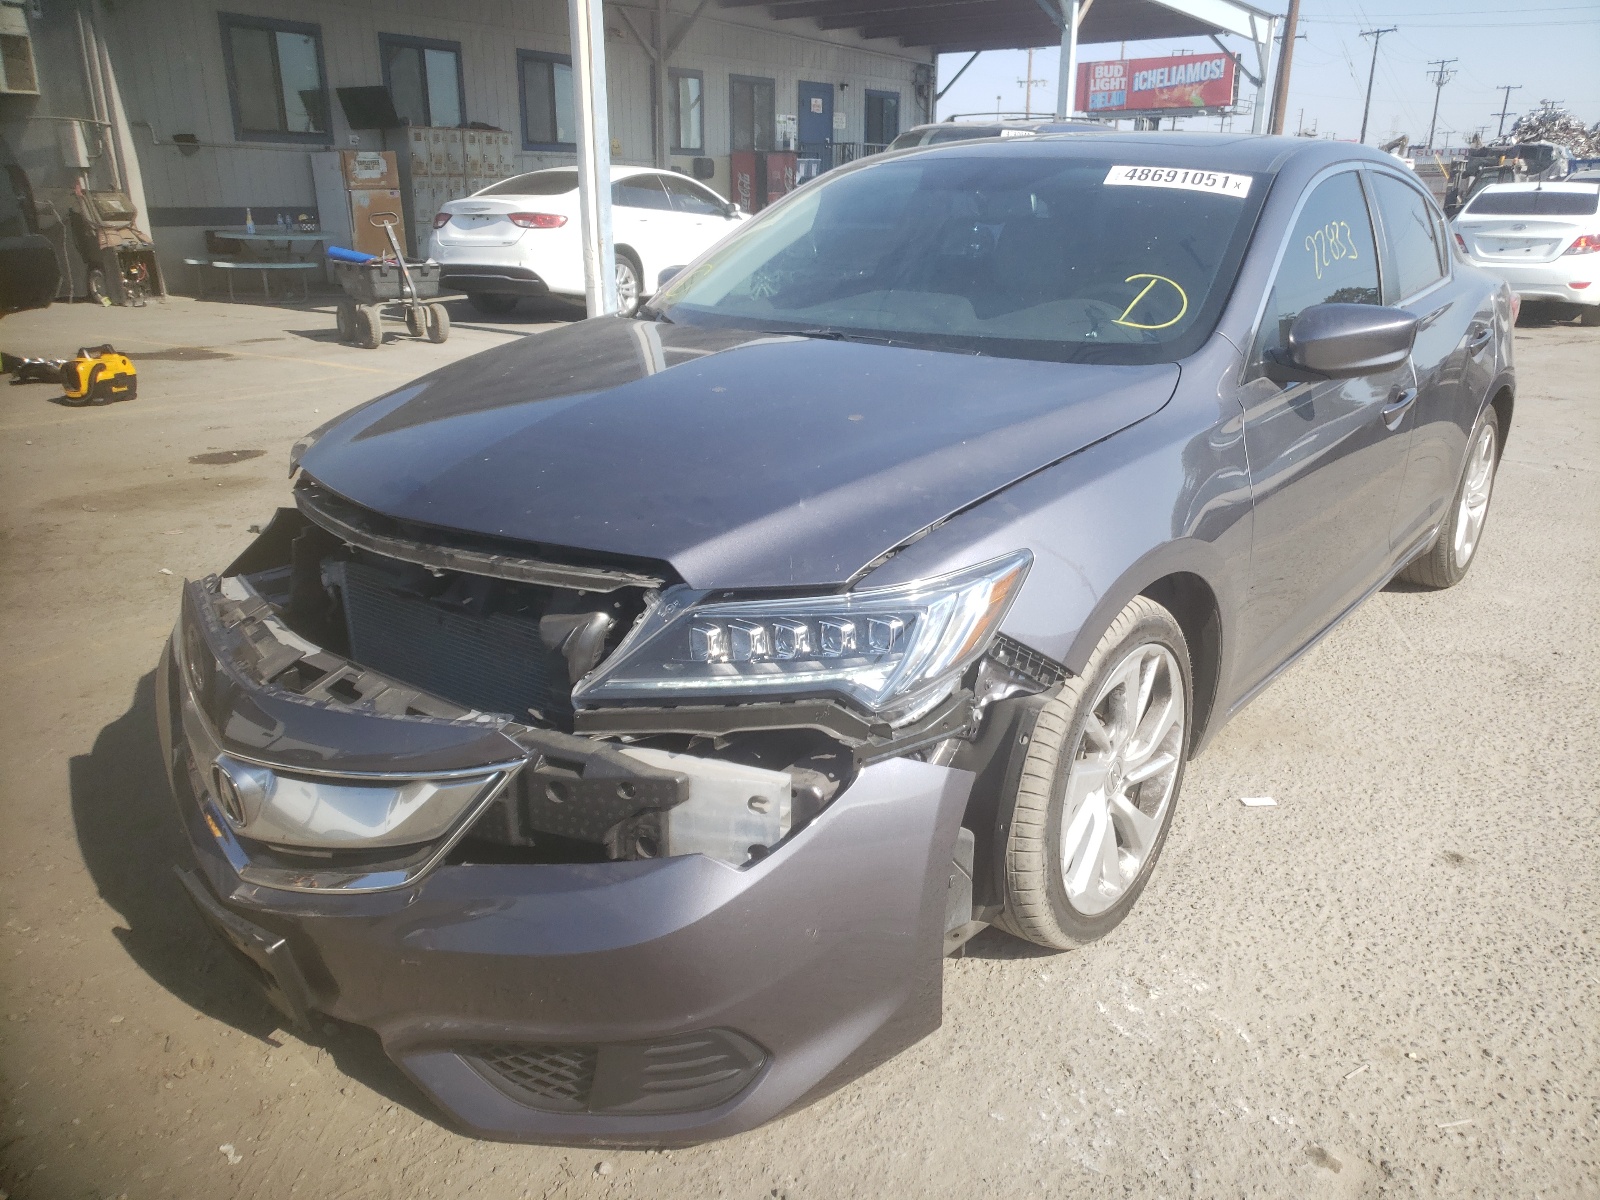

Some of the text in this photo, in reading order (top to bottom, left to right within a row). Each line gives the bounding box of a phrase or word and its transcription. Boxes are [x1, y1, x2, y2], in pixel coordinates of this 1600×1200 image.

[1095, 65, 1123, 78] BUD
[1090, 77, 1127, 91] LIGHT
[1124, 168, 1230, 189] 48691051
[1111, 273, 1188, 329] D
